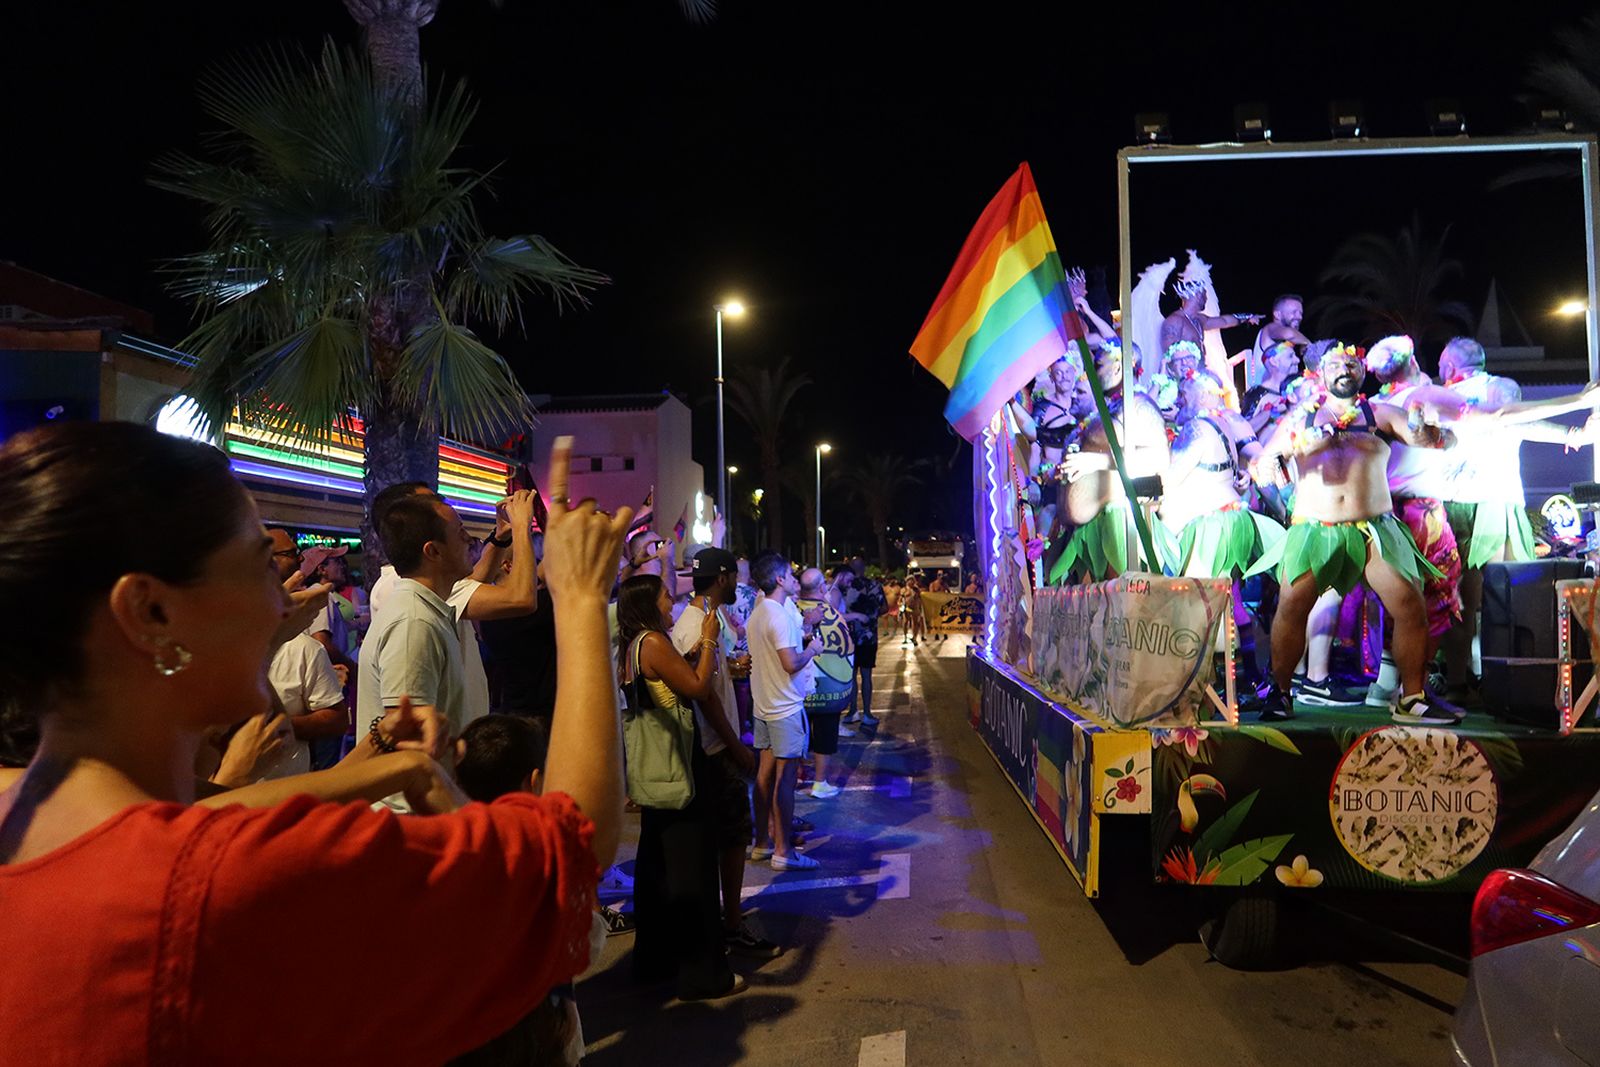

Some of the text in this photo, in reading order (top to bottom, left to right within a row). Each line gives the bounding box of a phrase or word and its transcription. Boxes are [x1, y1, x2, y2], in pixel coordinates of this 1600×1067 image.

[983, 676, 1028, 768] BOTANIC
[1343, 789, 1487, 814] BOTANIC
[1379, 814, 1450, 825] DISCOTECA
